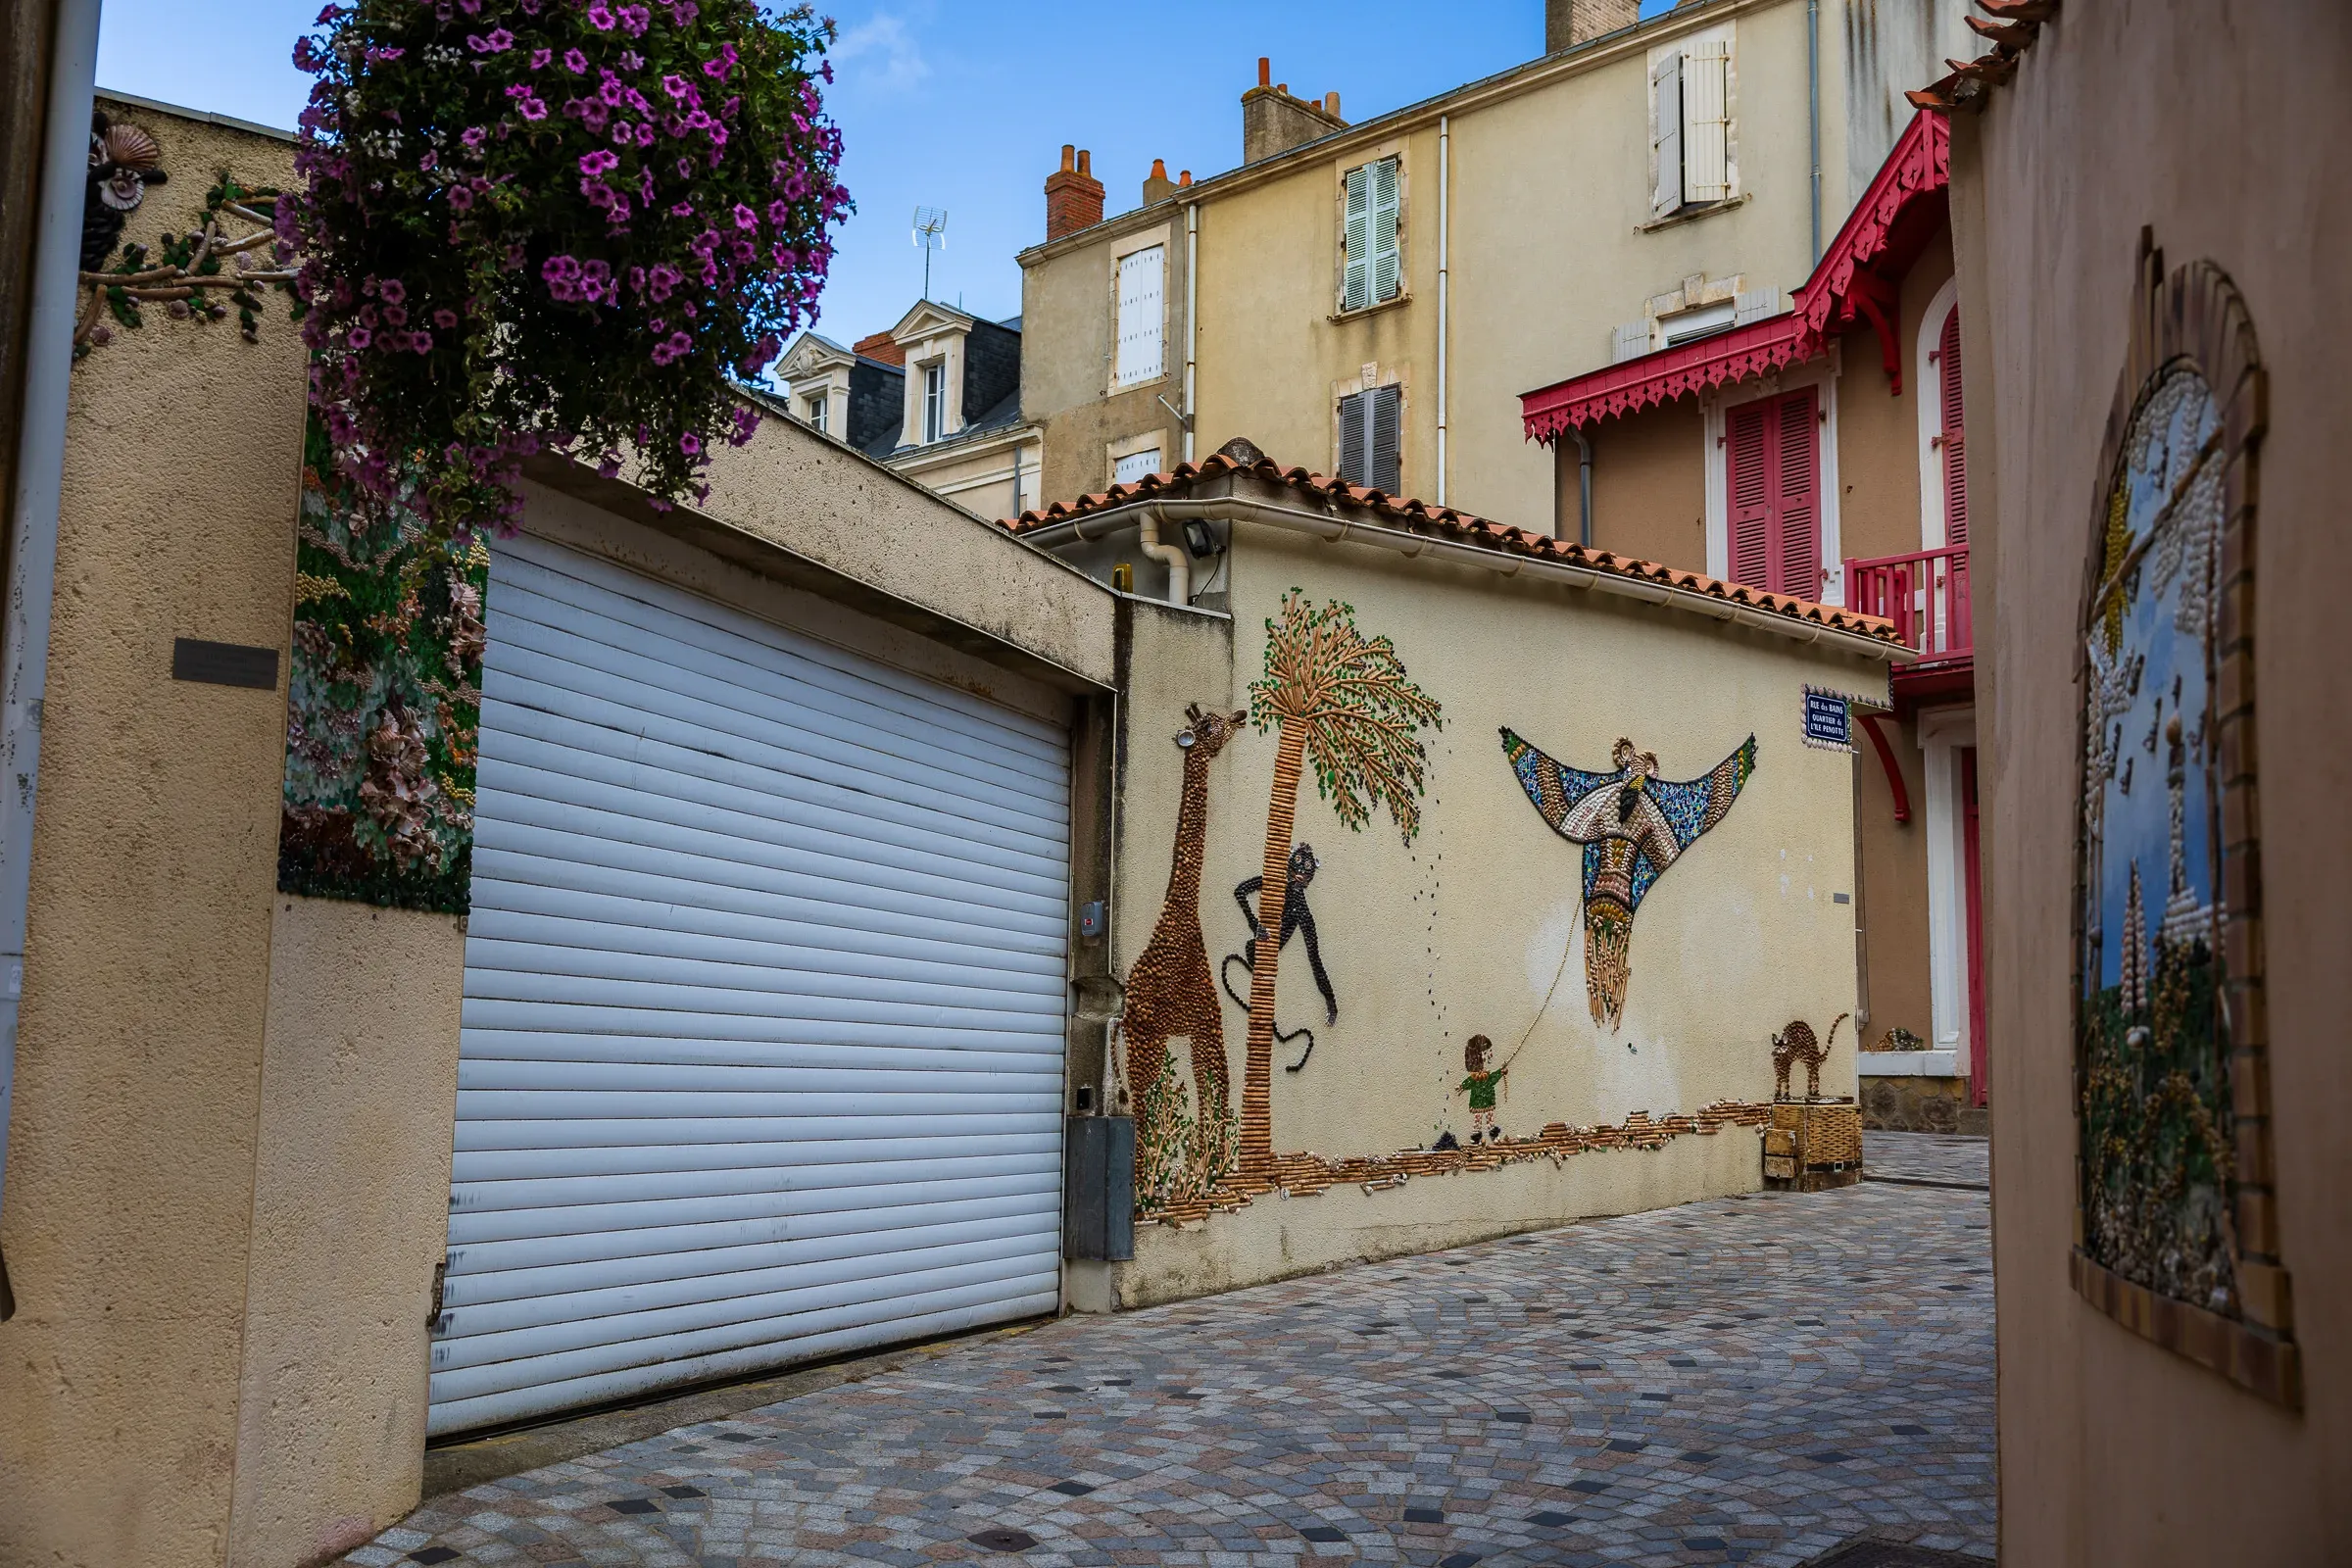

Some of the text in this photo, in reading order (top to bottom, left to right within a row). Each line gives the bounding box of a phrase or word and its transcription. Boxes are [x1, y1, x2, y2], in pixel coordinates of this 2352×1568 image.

[1811, 700, 1819, 709] RUE
[1829, 704, 1843, 714] BAINS
[1812, 714, 1836, 724] QUARTIER
[1823, 725, 1844, 735] PENOTTE
